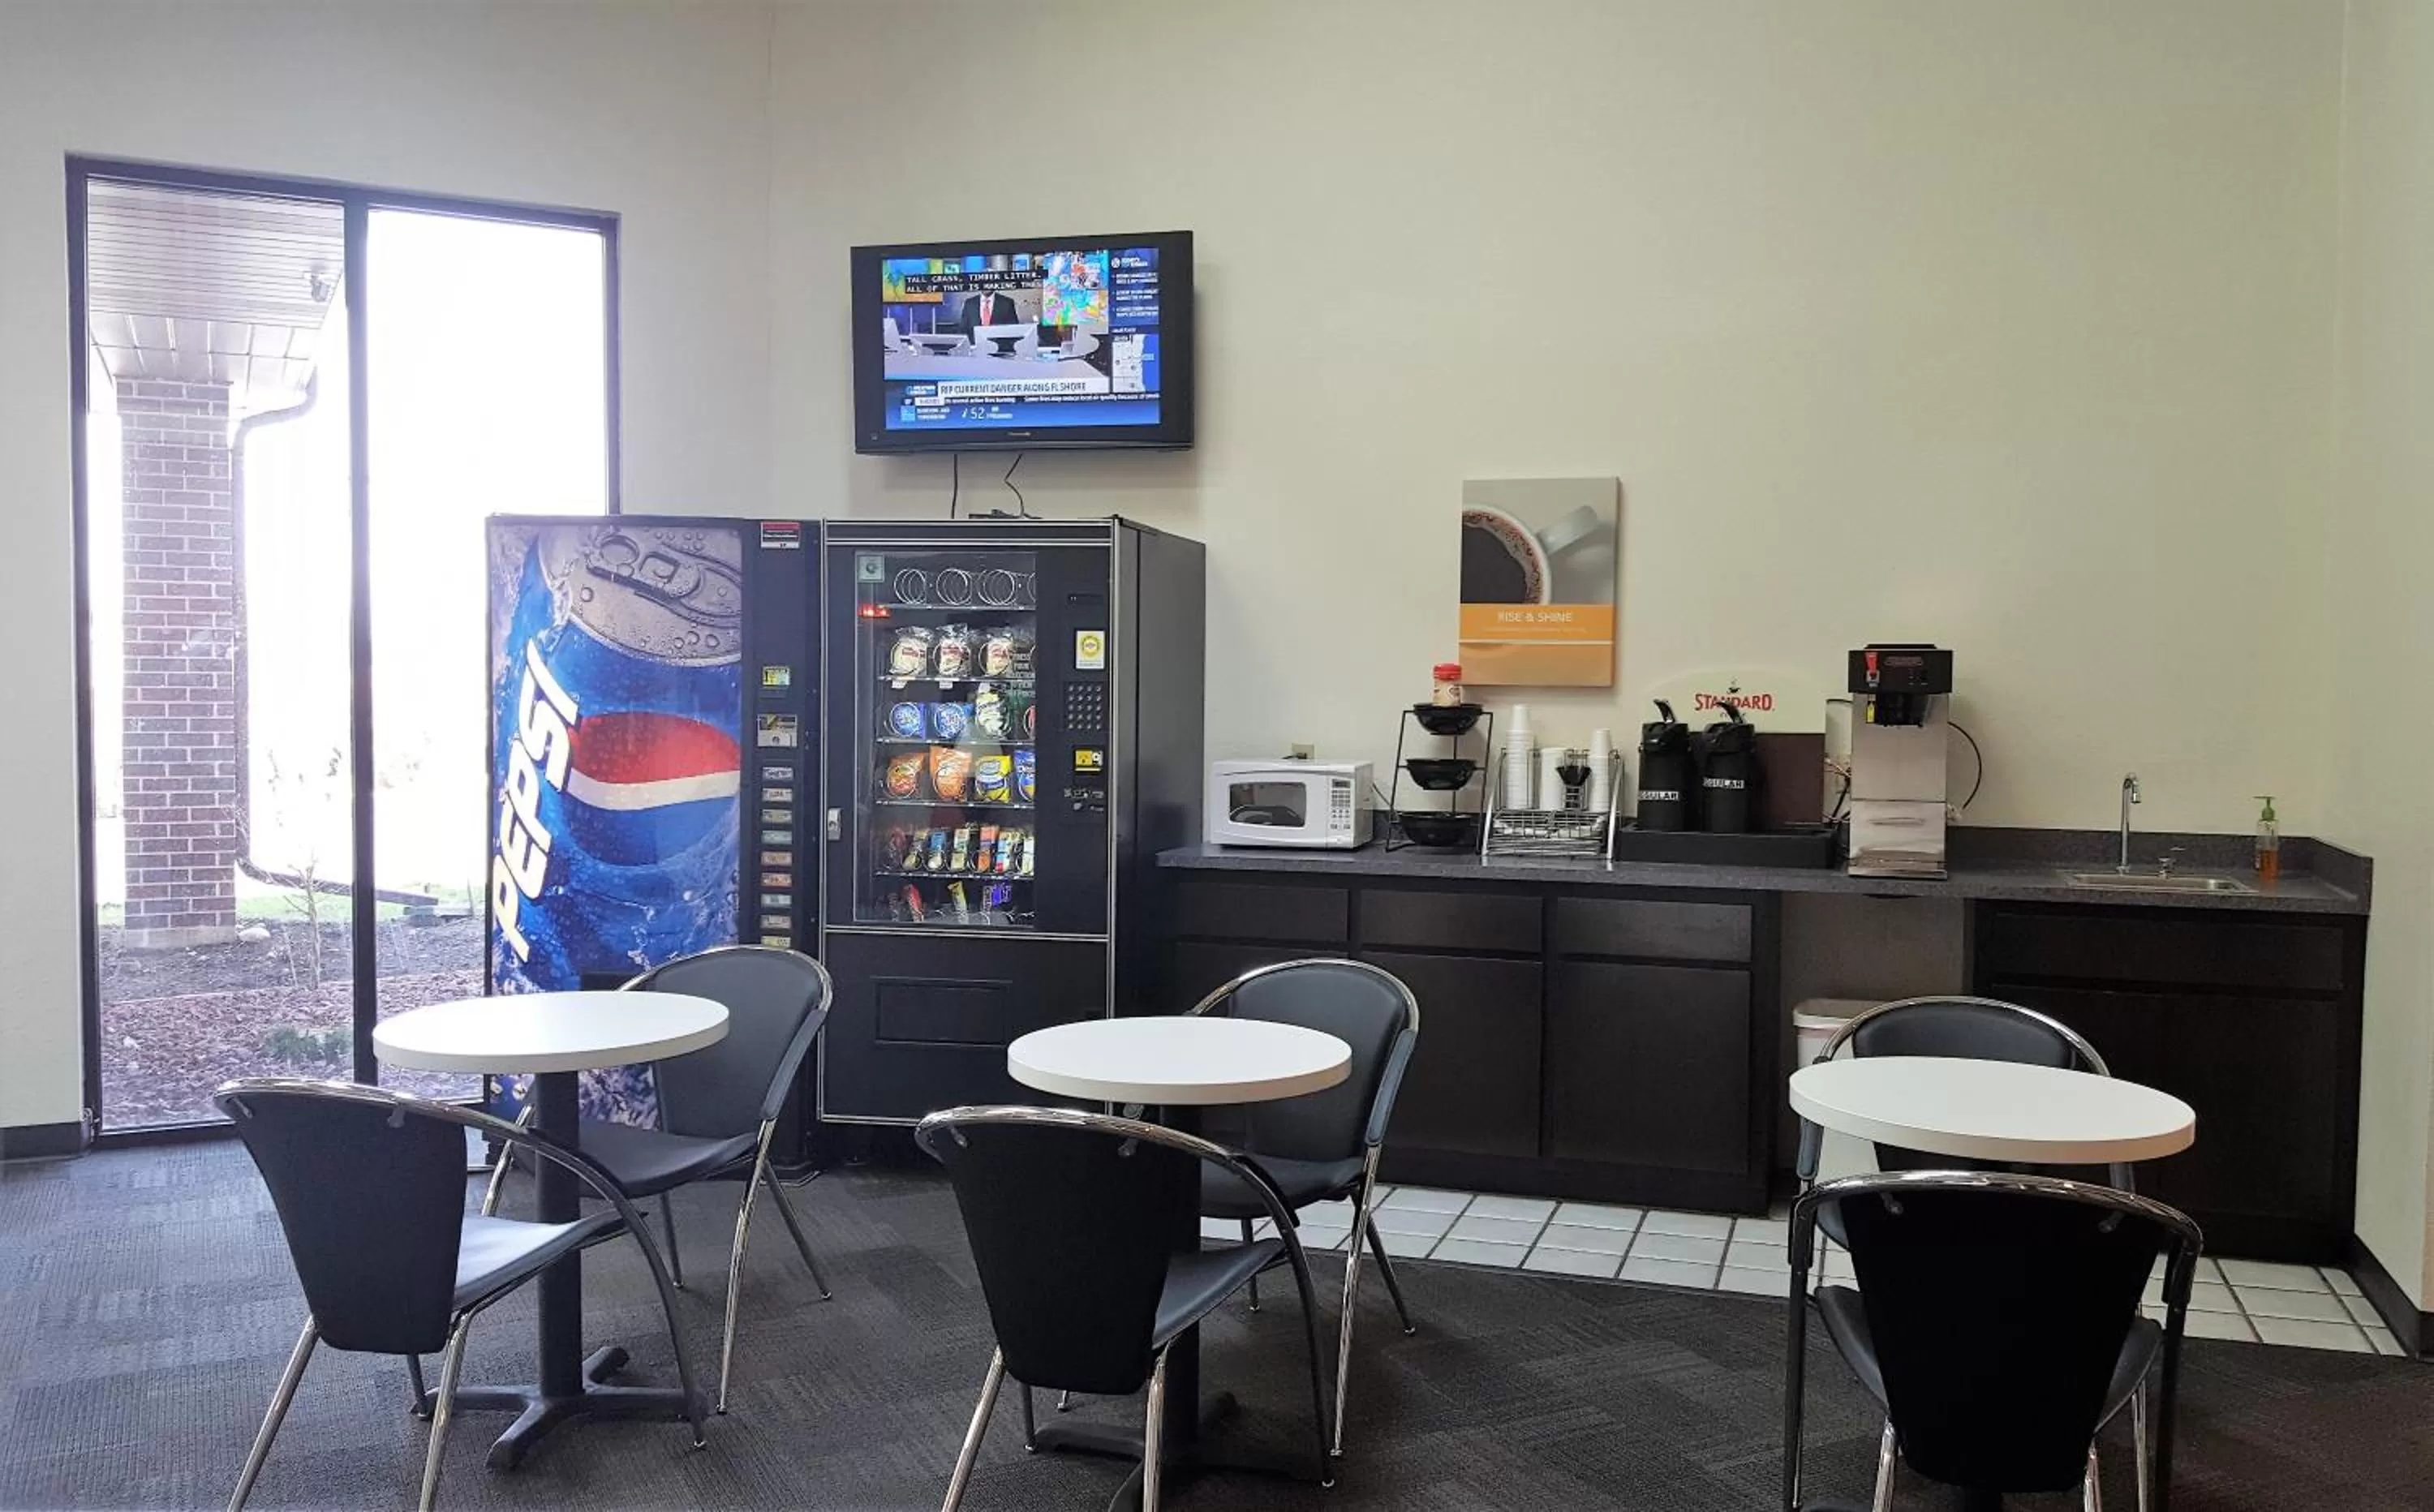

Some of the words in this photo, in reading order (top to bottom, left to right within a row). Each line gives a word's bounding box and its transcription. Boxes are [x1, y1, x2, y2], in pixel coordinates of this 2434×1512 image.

[954, 384, 989, 394] CURRENT
[991, 383, 1022, 393] DANGER
[1023, 382, 1050, 392] ALONG
[1060, 381, 1086, 392] SHORE
[1498, 612, 1521, 621] RISE
[1537, 612, 1572, 622] SHINE
[492, 638, 579, 963] PEPSI
